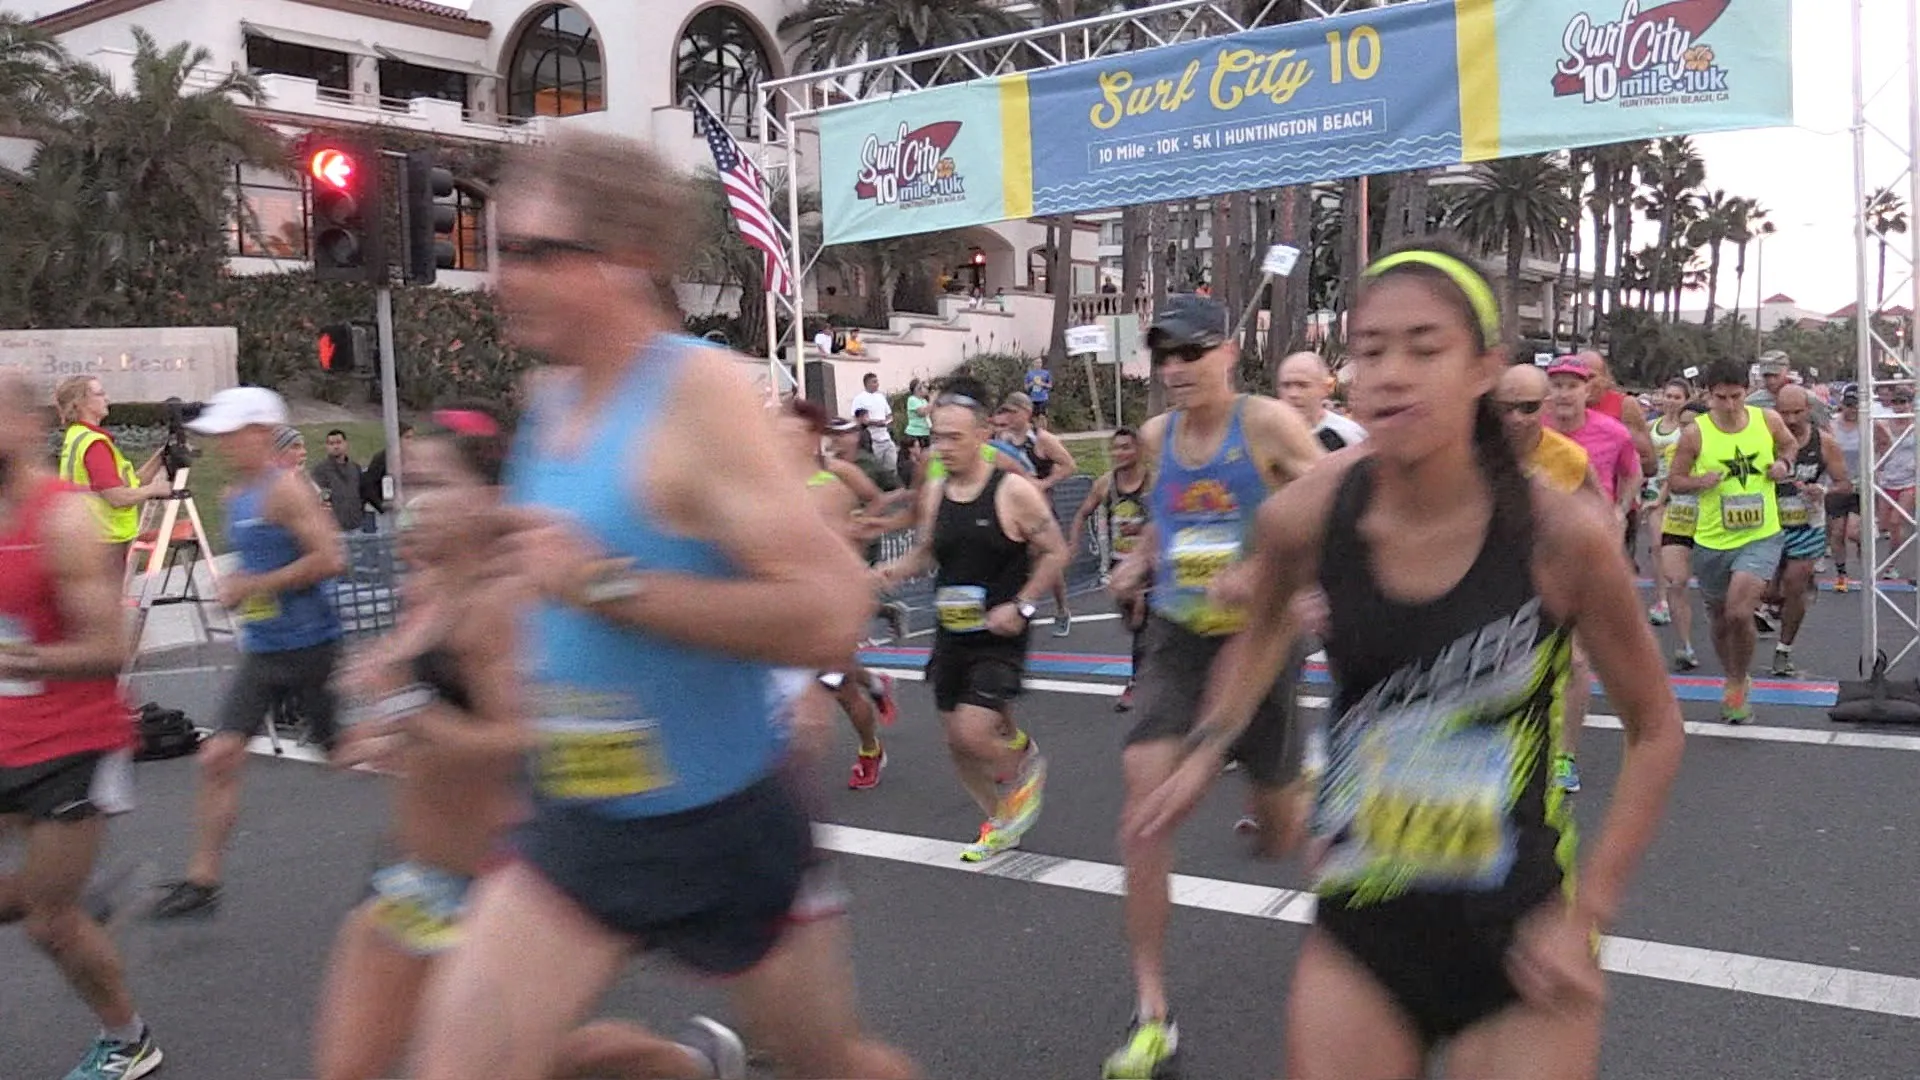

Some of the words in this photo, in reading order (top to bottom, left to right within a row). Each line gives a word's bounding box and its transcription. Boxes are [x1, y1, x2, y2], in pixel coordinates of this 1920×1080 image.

[1557, 0, 1639, 75] Surf
[1627, 17, 1691, 81] City
[1089, 59, 1200, 129] Surf
[1209, 48, 1314, 110] City
[1325, 25, 1381, 84] 10
[1579, 62, 1618, 102] 10
[858, 123, 908, 184] Surf
[902, 137, 941, 186] City
[1099, 148, 1113, 164] 10
[1116, 142, 1146, 160] Mile
[1156, 137, 1180, 154] 10K
[1192, 133, 1212, 150] 5K
[1224, 117, 1317, 146] HUNTINGTON
[1322, 109, 1373, 132] BEACH
[873, 173, 898, 205] 10
[1727, 508, 1761, 524] 1101
